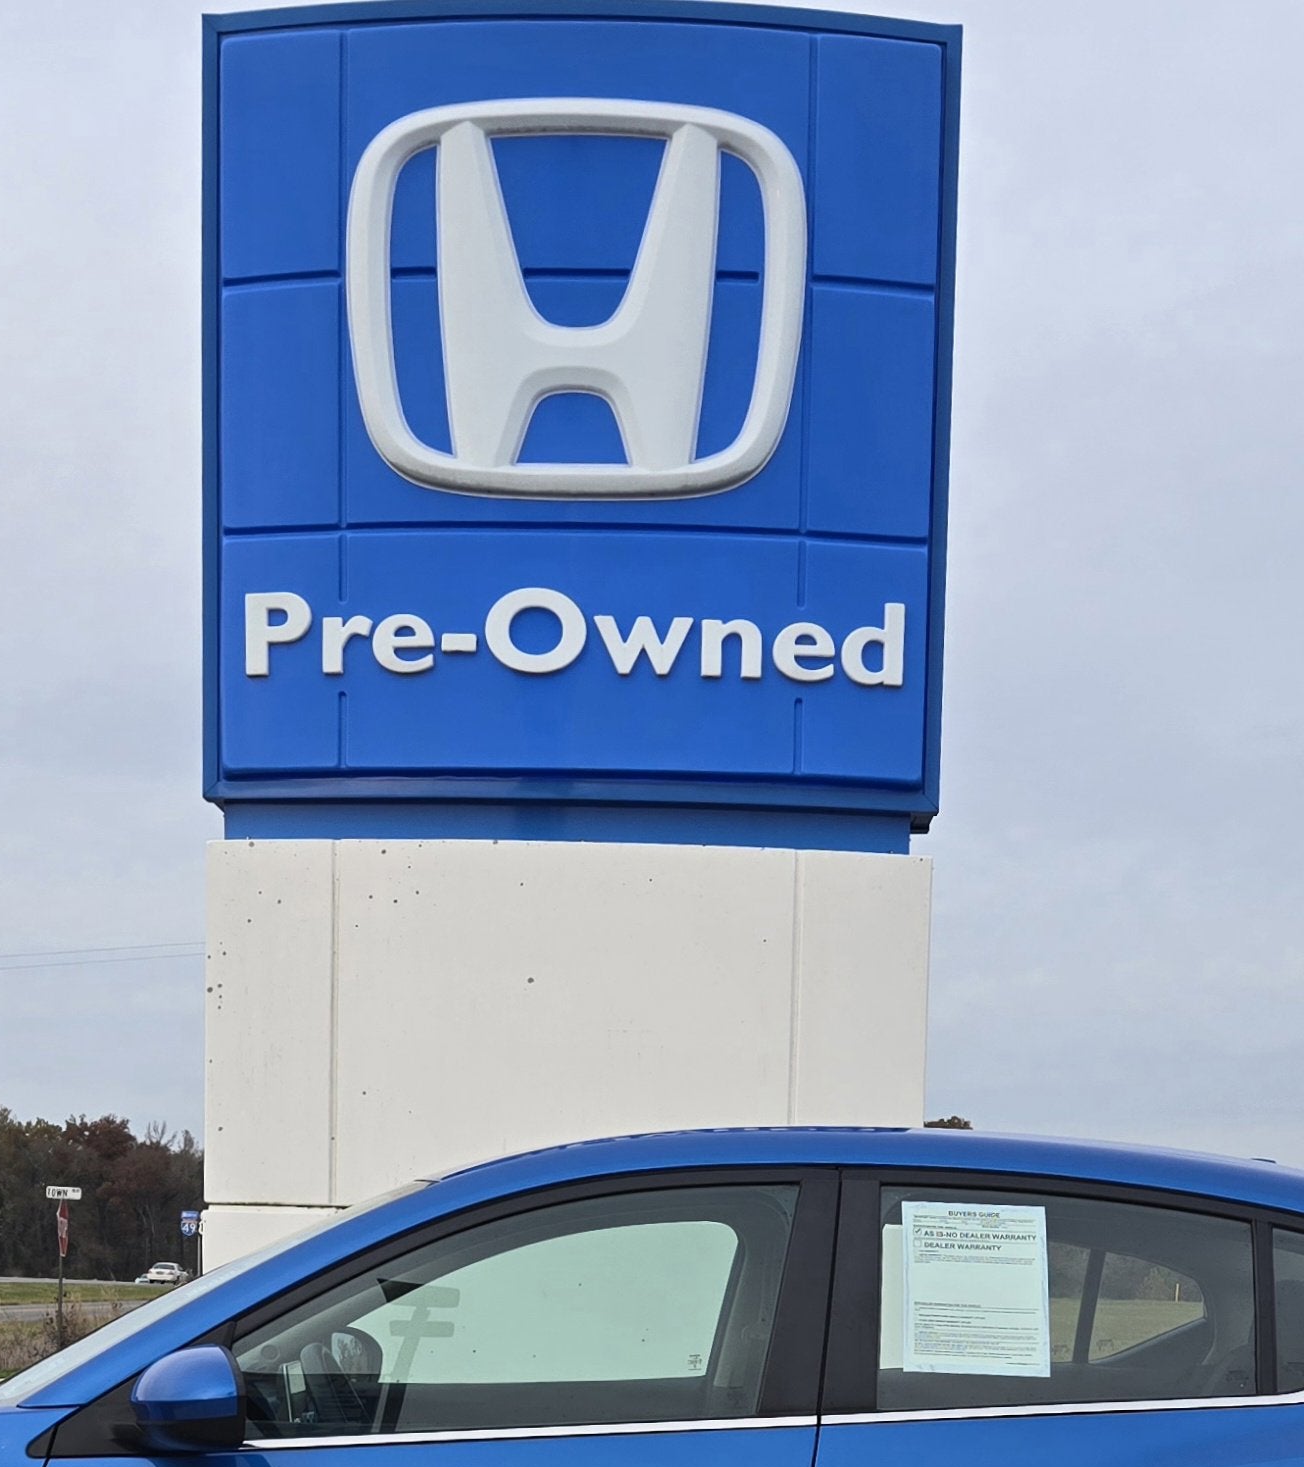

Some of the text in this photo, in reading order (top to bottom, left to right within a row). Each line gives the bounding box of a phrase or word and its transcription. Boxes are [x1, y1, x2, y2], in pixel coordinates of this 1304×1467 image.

[244, 587, 906, 687] Pre-Owned
[182, 1223, 196, 1234] 49
[992, 1233, 1036, 1241] WARRANTY
[924, 1241, 1002, 1251] DEALER WARRANTY
